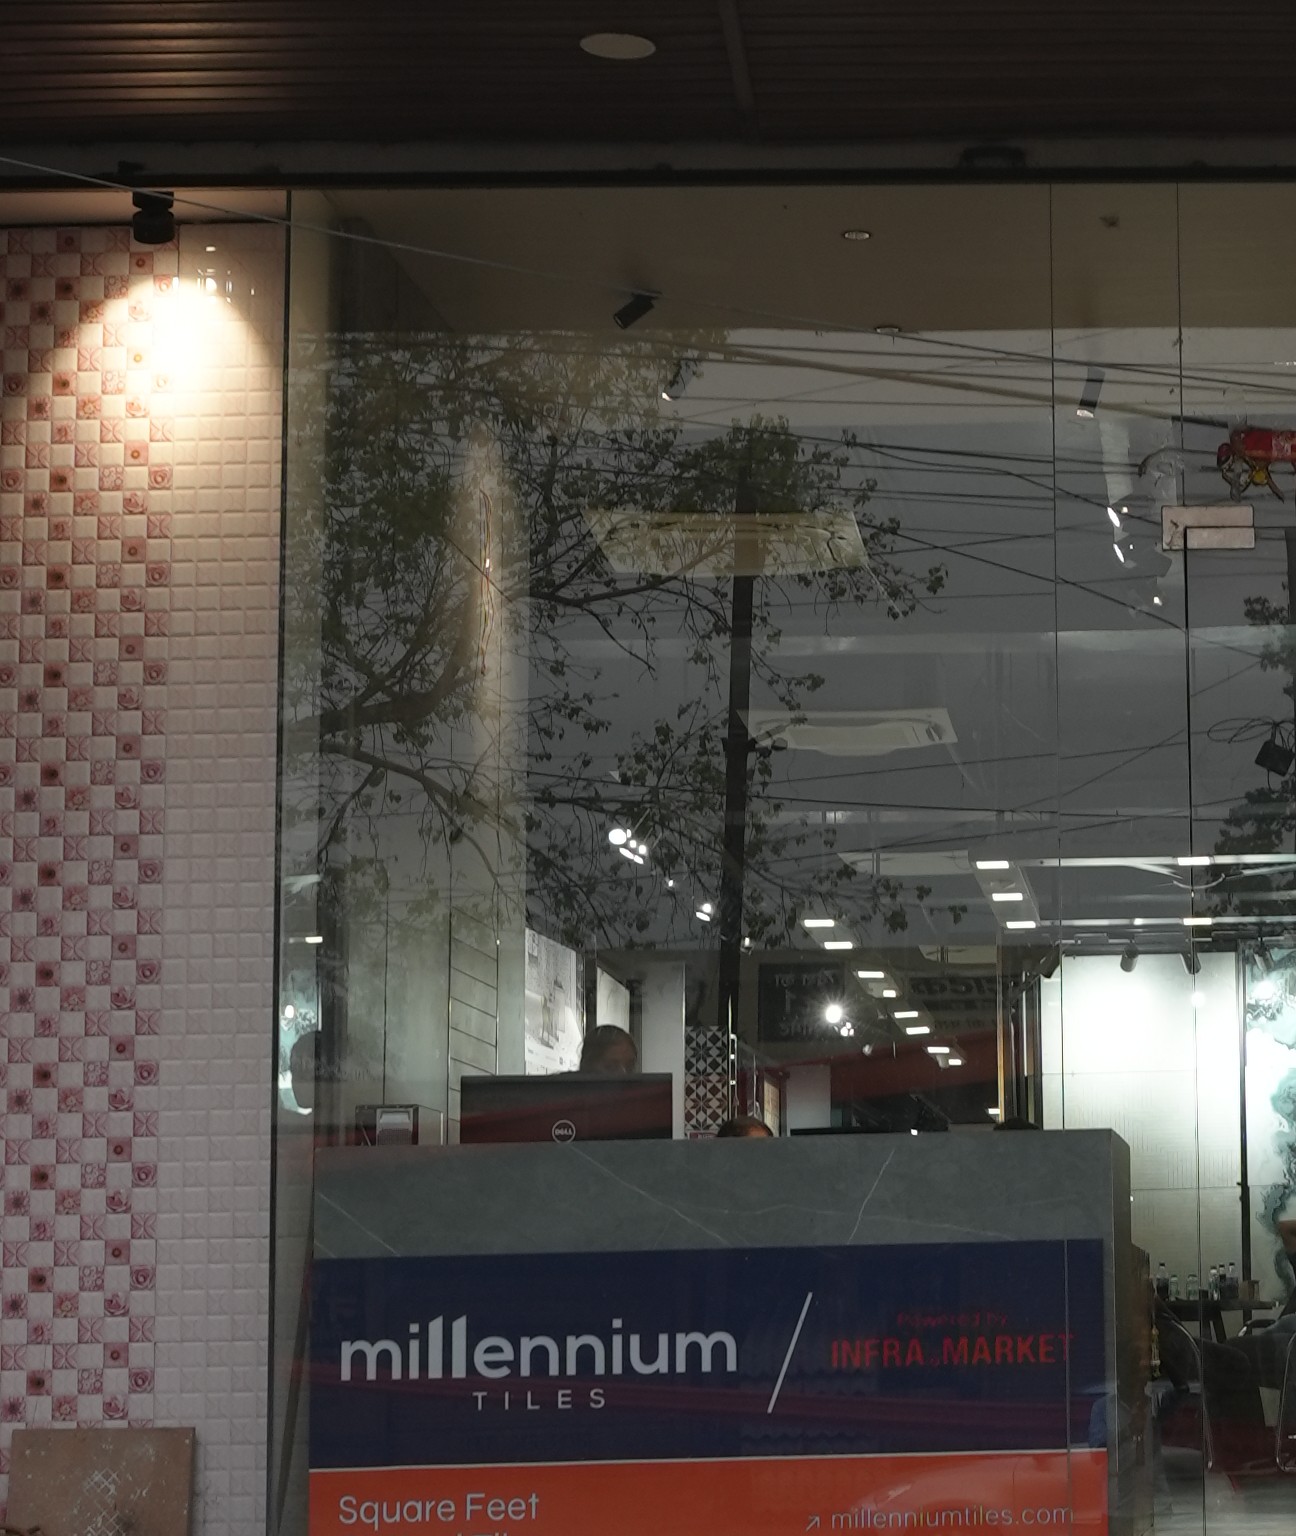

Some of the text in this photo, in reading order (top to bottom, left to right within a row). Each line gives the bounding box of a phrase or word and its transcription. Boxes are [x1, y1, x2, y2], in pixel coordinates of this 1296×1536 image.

[340, 1314, 739, 1382] millennium
[472, 1387, 608, 1412] TILES
[337, 1492, 540, 1532] Square Feet
[830, 1500, 1075, 1529] millenniumtiles.com
